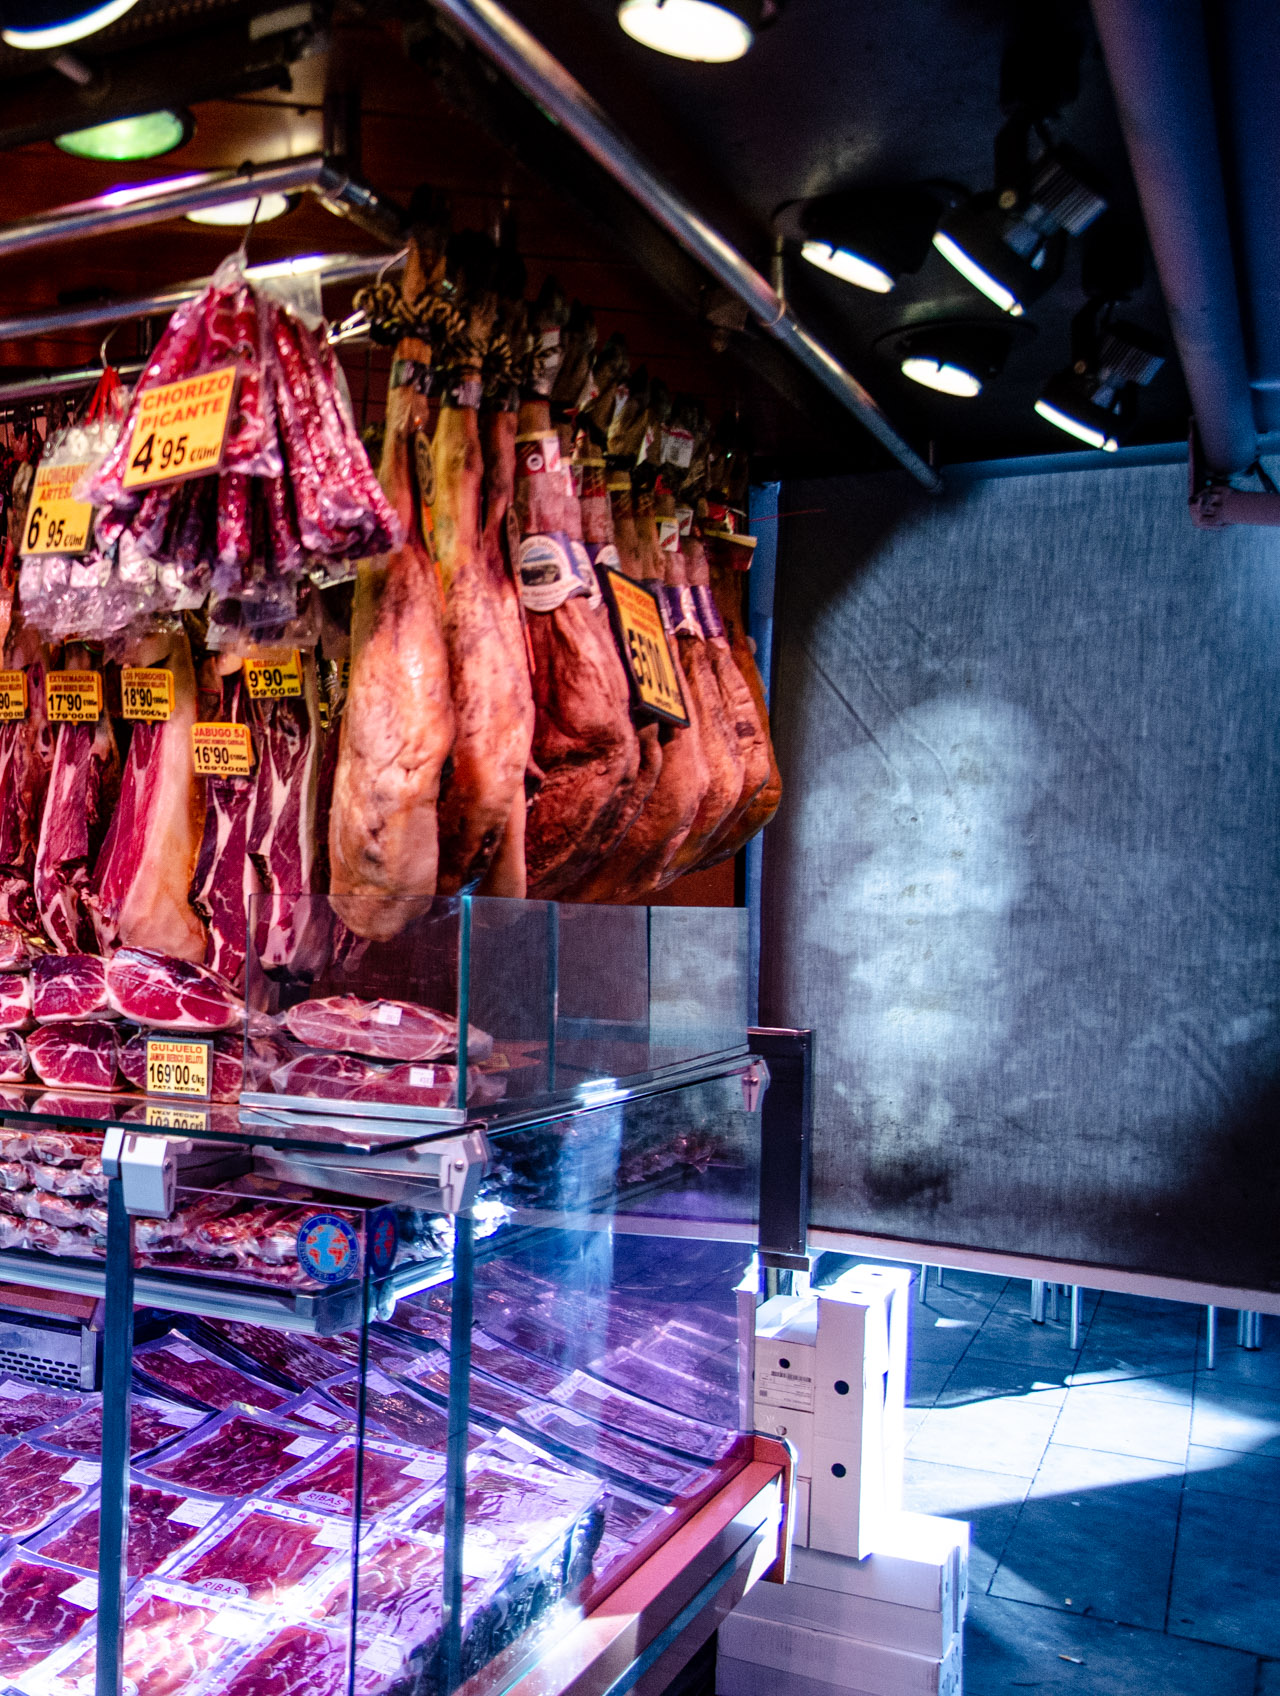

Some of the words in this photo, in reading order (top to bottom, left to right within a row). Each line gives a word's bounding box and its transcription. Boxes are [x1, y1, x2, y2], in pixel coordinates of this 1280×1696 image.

[143, 375, 231, 411] CHORIZO
[140, 397, 224, 432] PICANTE
[132, 433, 189, 474] 4'95
[27, 506, 65, 549] 6'95
[249, 669, 283, 687] 9'90
[124, 688, 152, 707] 18'90
[252, 688, 286, 697] 99'00
[48, 693, 82, 711] 17'90
[194, 728, 232, 738] JABUGO
[195, 746, 230, 765] 16'90
[150, 1043, 203, 1054] GUIJUELO
[149, 1063, 190, 1085] 169'00
[306, 1492, 344, 1506] RIBAS
[203, 1581, 241, 1595] RIBAS
